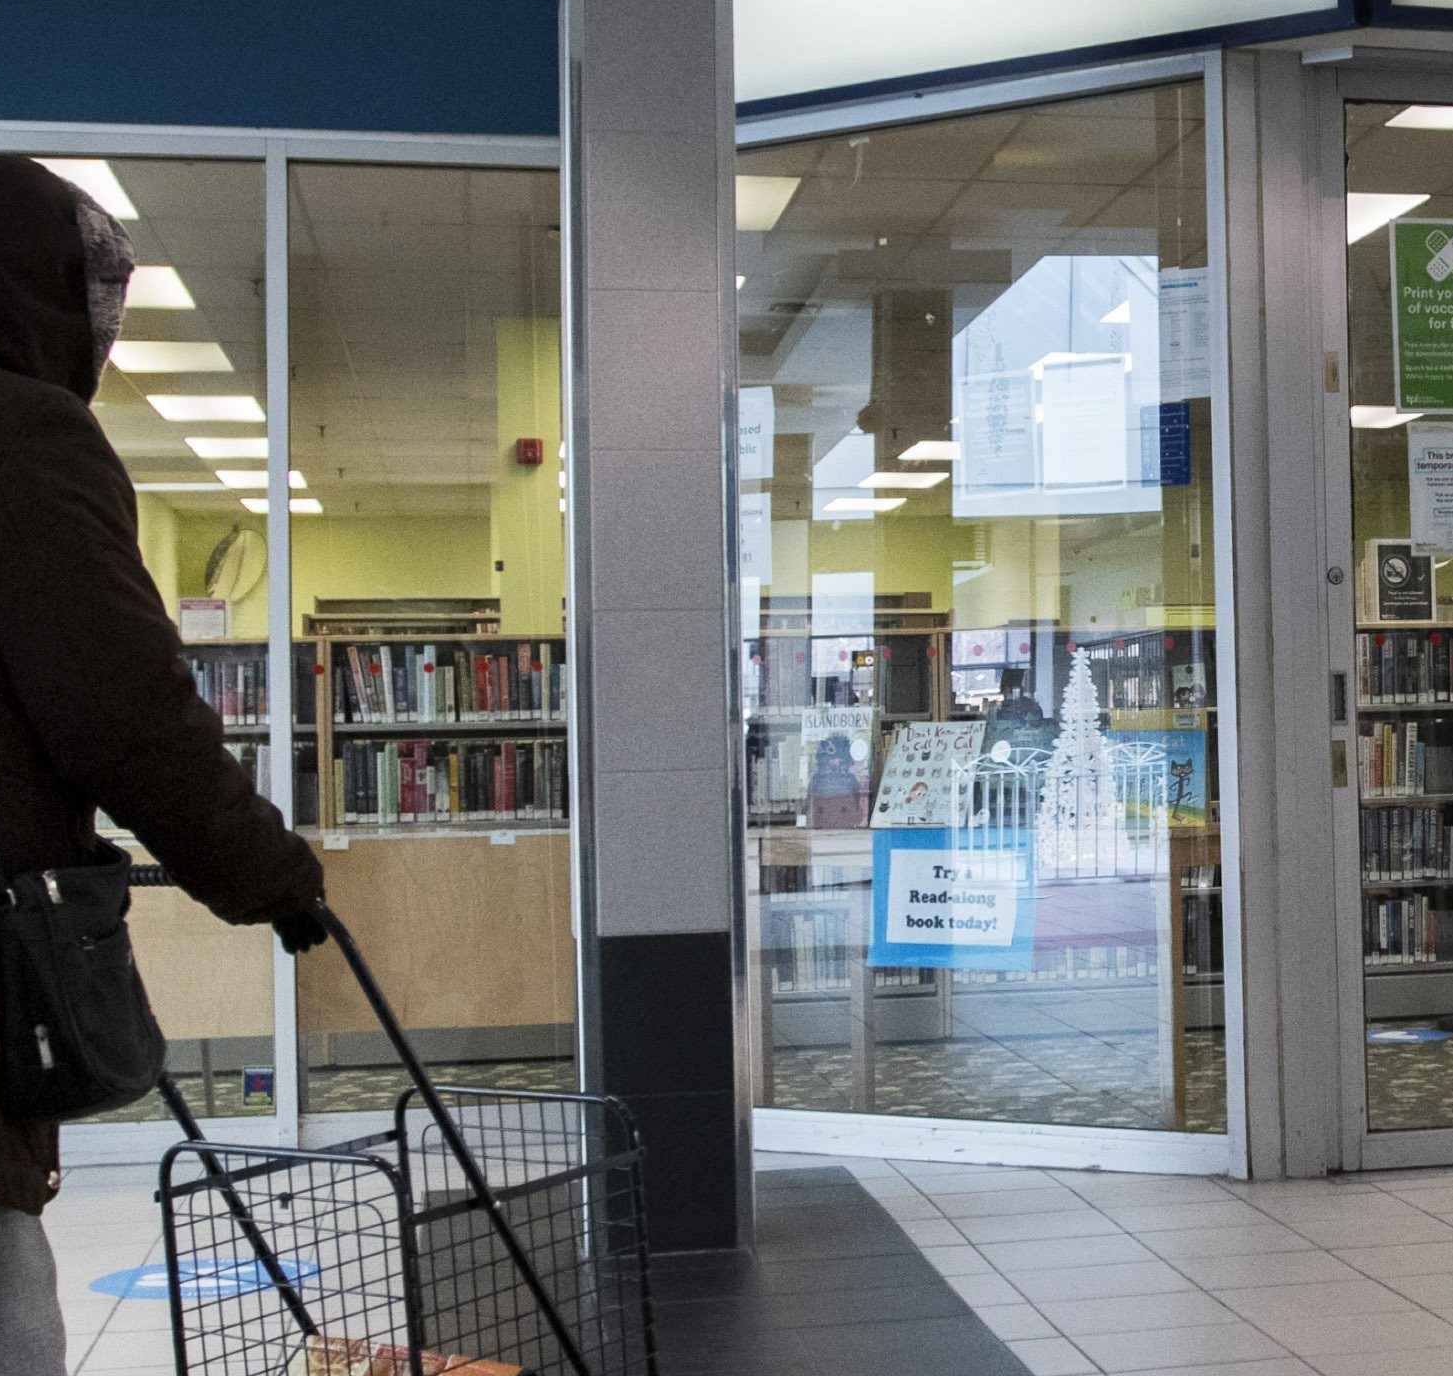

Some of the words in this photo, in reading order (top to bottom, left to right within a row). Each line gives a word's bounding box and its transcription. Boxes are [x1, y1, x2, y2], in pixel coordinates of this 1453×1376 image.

[1403, 286, 1434, 299] Print
[1407, 302, 1421, 314] of
[1429, 317, 1446, 330] for
[1427, 451, 1444, 460] This
[806, 712, 870, 729] ISLANDBORN
[913, 740, 932, 751] Call
[953, 736, 974, 751] Cat
[932, 865, 960, 882] Try
[909, 890, 996, 908] Read-along
[905, 914, 944, 929] book
[948, 916, 998, 933] today!
